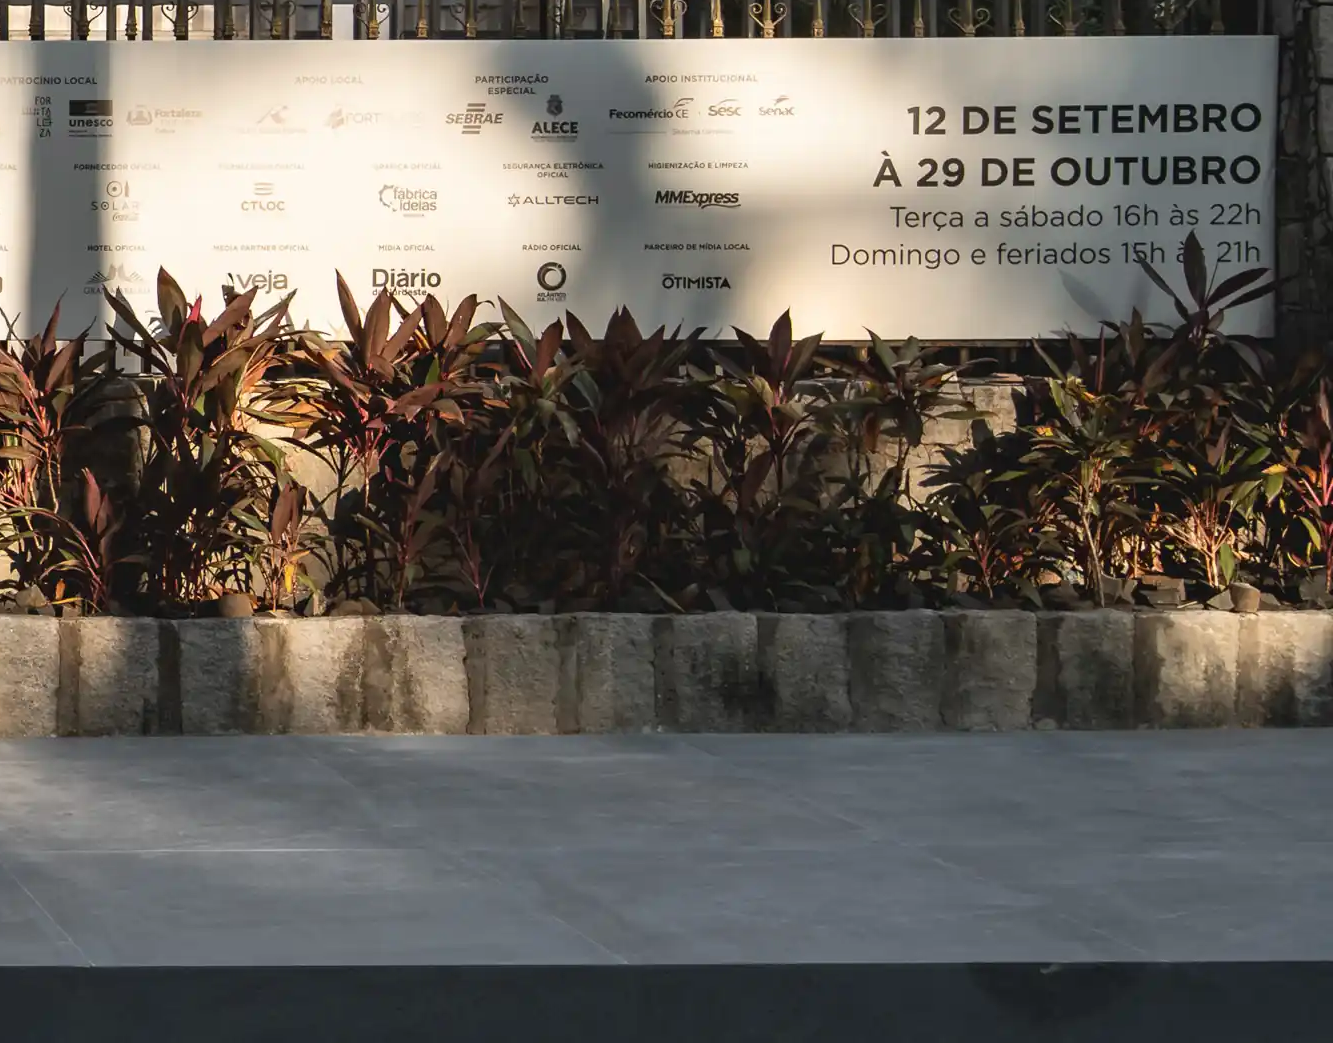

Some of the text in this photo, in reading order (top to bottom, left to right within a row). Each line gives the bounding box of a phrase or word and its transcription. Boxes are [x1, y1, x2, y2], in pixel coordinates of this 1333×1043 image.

[64, 76, 98, 85] LOCAL
[474, 74, 549, 85] PARTICIPAÇÃO
[644, 75, 678, 83] APOIO
[487, 87, 536, 95] ESPECIAL
[444, 113, 504, 124] SEBRAE
[608, 108, 674, 120] Fecomércio
[907, 103, 1262, 135] 12 DE SETEMBRO
[68, 118, 114, 127] unesco
[531, 121, 579, 134] ALECE
[648, 161, 706, 170] HIGIENIZAÇÃO
[873, 151, 1262, 188] À 29 DE OUTUBRO
[522, 195, 599, 205] ALLTECH
[654, 190, 740, 207] MMExpress
[890, 203, 1261, 232] Terça a sábado 16h às 22h
[86, 244, 113, 252] HOTEL
[403, 244, 436, 252] OFICIAL
[550, 243, 582, 251] OFICIAL
[643, 243, 685, 251] PARCEIRO
[686, 243, 698, 251] DE
[723, 243, 751, 251] LOCAL
[832, 243, 961, 270] Domingo
[971, 248, 986, 265] e
[997, 241, 1111, 266] feriados
[1121, 241, 1165, 264] 15h
[1216, 240, 1261, 263] 21h
[236, 270, 289, 294] veja
[372, 268, 442, 288] Diário
